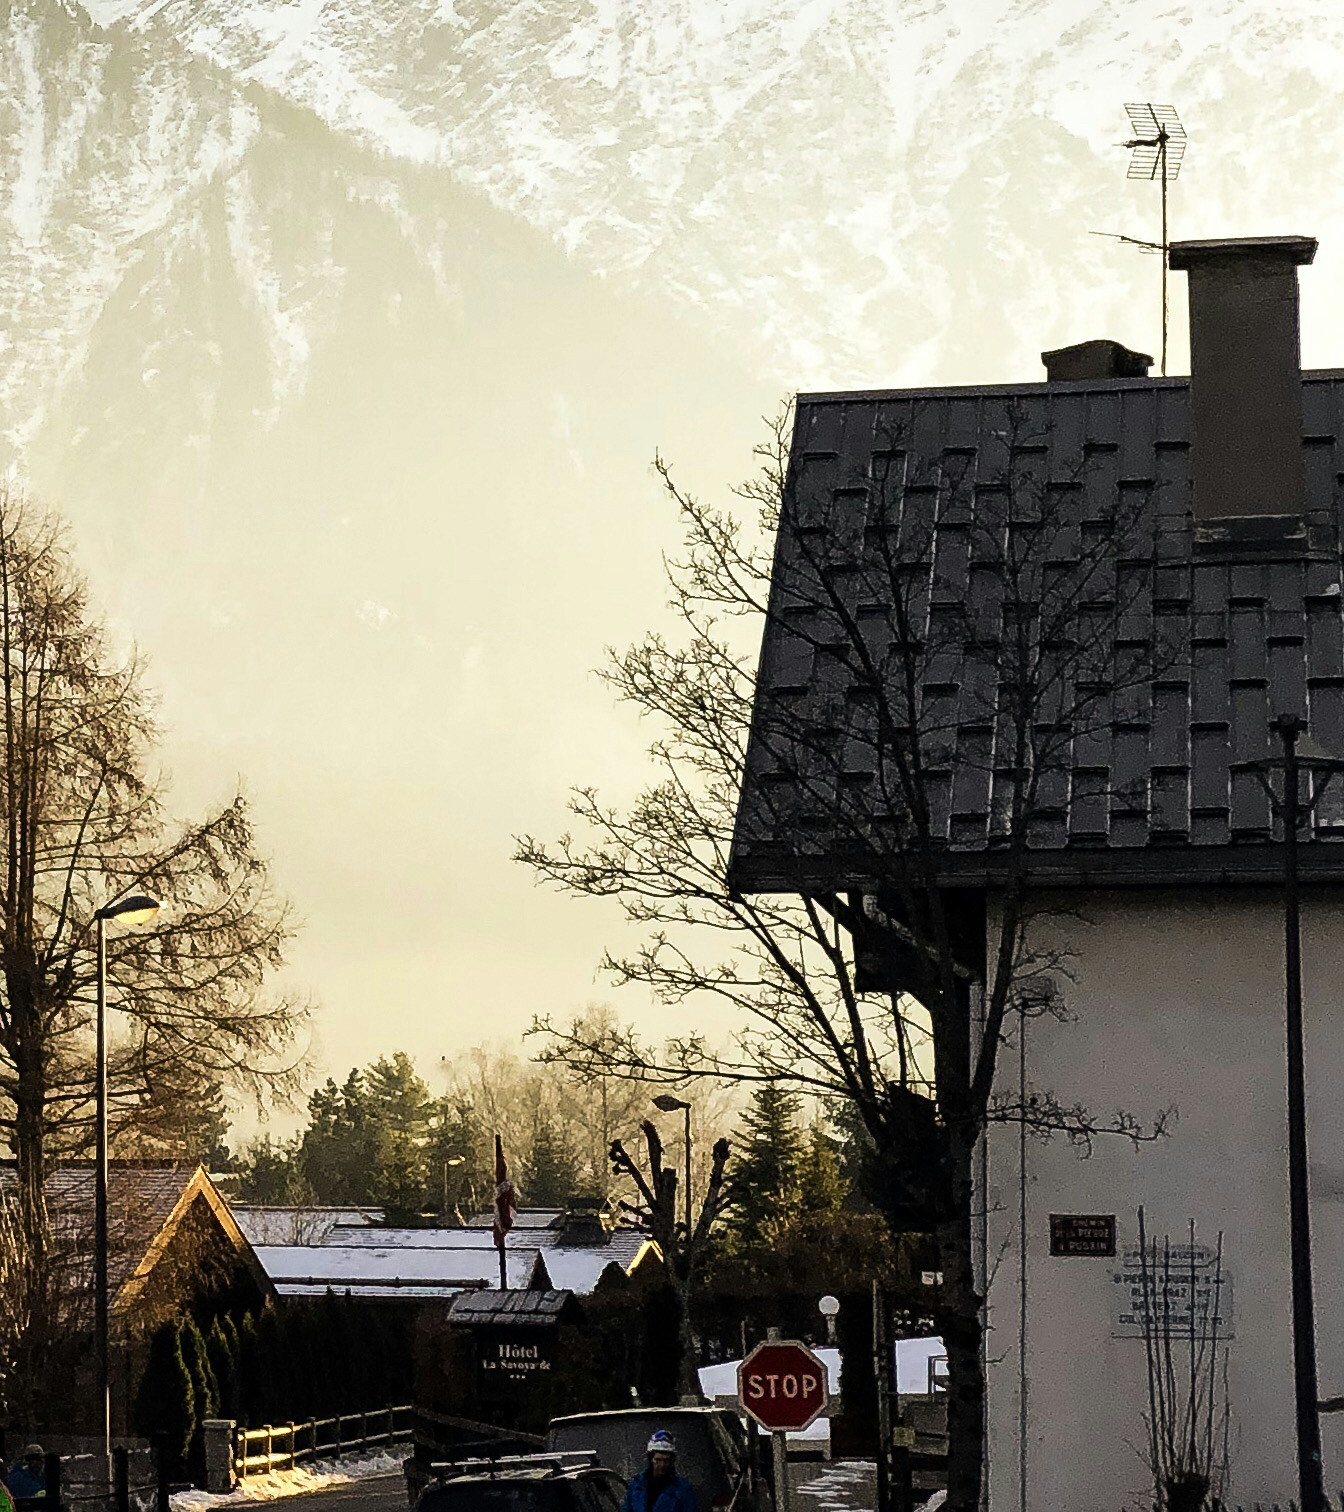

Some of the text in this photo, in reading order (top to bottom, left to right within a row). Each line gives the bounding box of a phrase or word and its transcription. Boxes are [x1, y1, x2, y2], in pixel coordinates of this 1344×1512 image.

[499, 1343, 538, 1358] Hôtel
[482, 1359, 496, 1369] La
[748, 1374, 817, 1399] STOP
